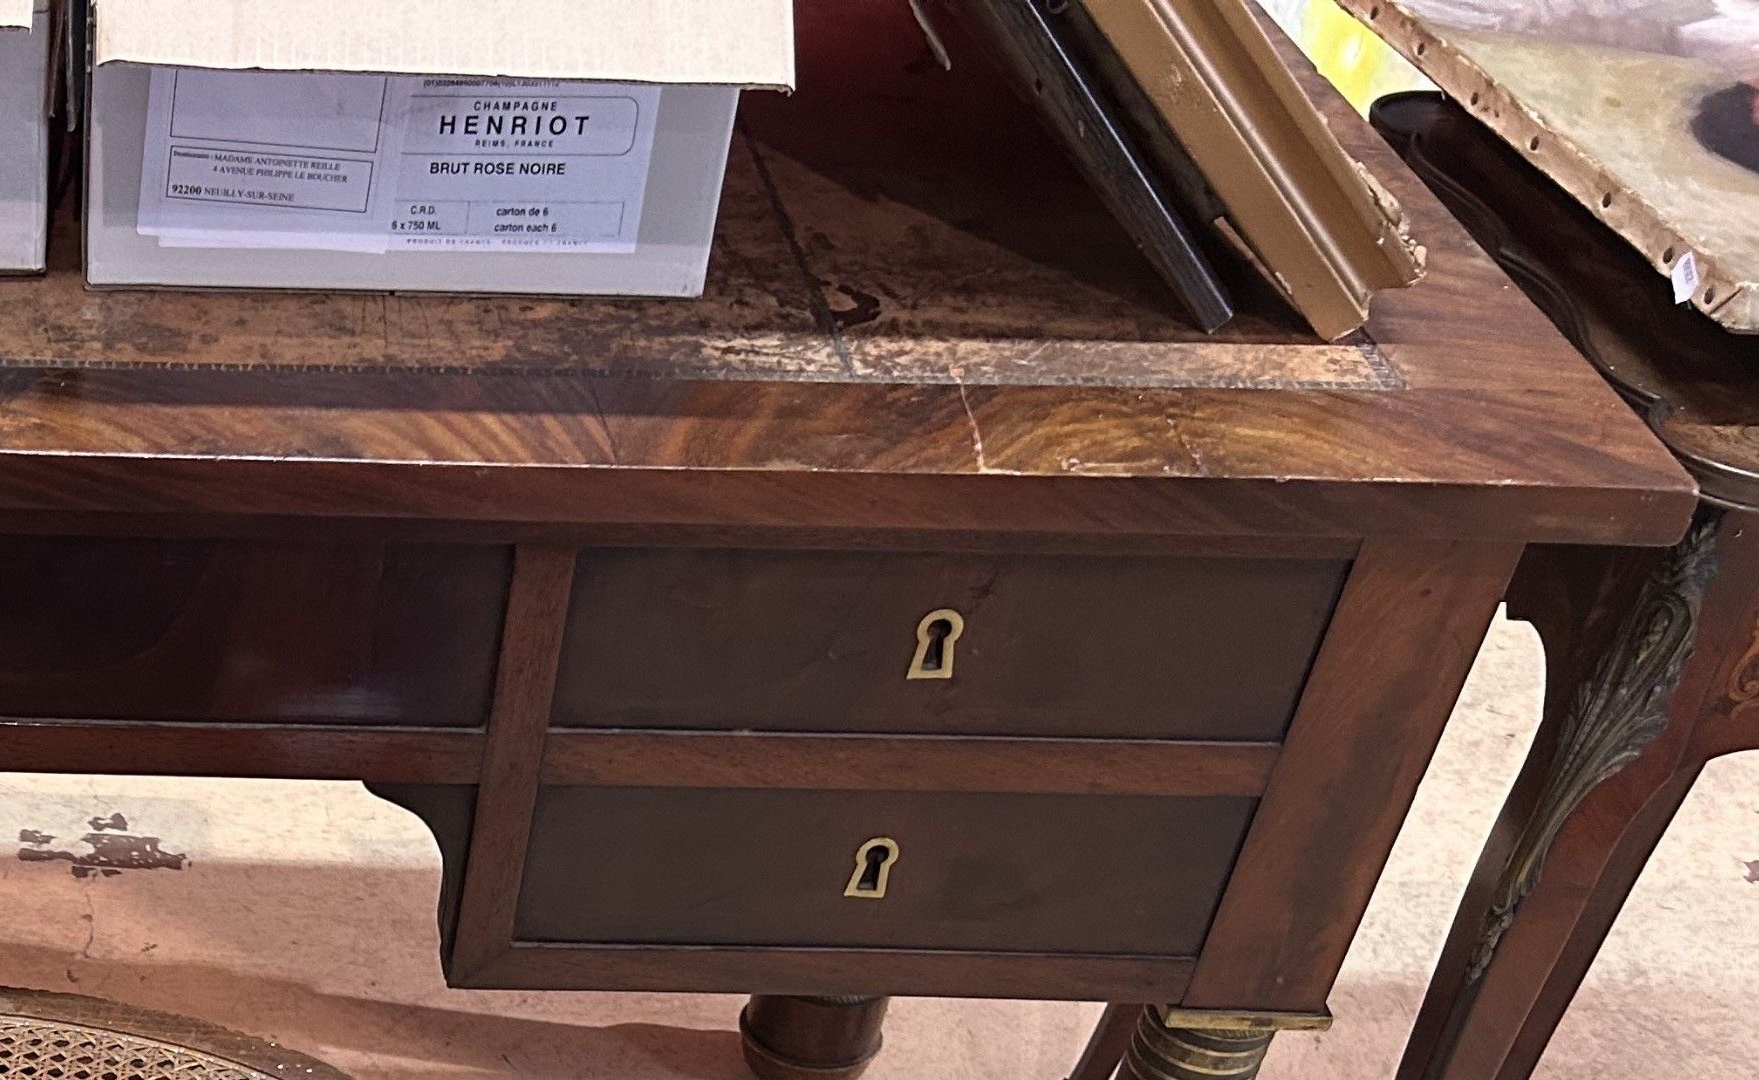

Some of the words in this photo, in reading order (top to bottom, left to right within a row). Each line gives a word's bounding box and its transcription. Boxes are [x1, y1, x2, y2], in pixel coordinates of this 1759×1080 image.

[473, 100, 558, 112] CHAMPAGNE
[439, 115, 590, 136] HENRIOT
[514, 139, 554, 148] FRANCE
[213, 154, 254, 165] MADAME
[255, 157, 309, 169] ANTOINETTE
[212, 165, 218, 173] 4
[218, 166, 255, 176] AVENUE
[255, 168, 293, 179] PHILIPPE
[294, 171, 306, 180] LE
[307, 172, 348, 183] BOUCHER
[429, 162, 470, 175] BRUT
[473, 162, 515, 175] ROSE
[519, 162, 567, 175] NOIRE
[171, 184, 202, 195] 92200
[203, 187, 295, 201] NEUILLY-SUR-SEINE
[496, 207, 526, 217] carton
[528, 207, 541, 217] de
[543, 207, 549, 217] 6
[391, 220, 398, 230] 6
[399, 222, 405, 230] x
[407, 220, 425, 231] 750
[427, 220, 441, 231] ML
[494, 223, 524, 233] carton
[526, 223, 549, 233] each
[551, 223, 557, 233] 6
